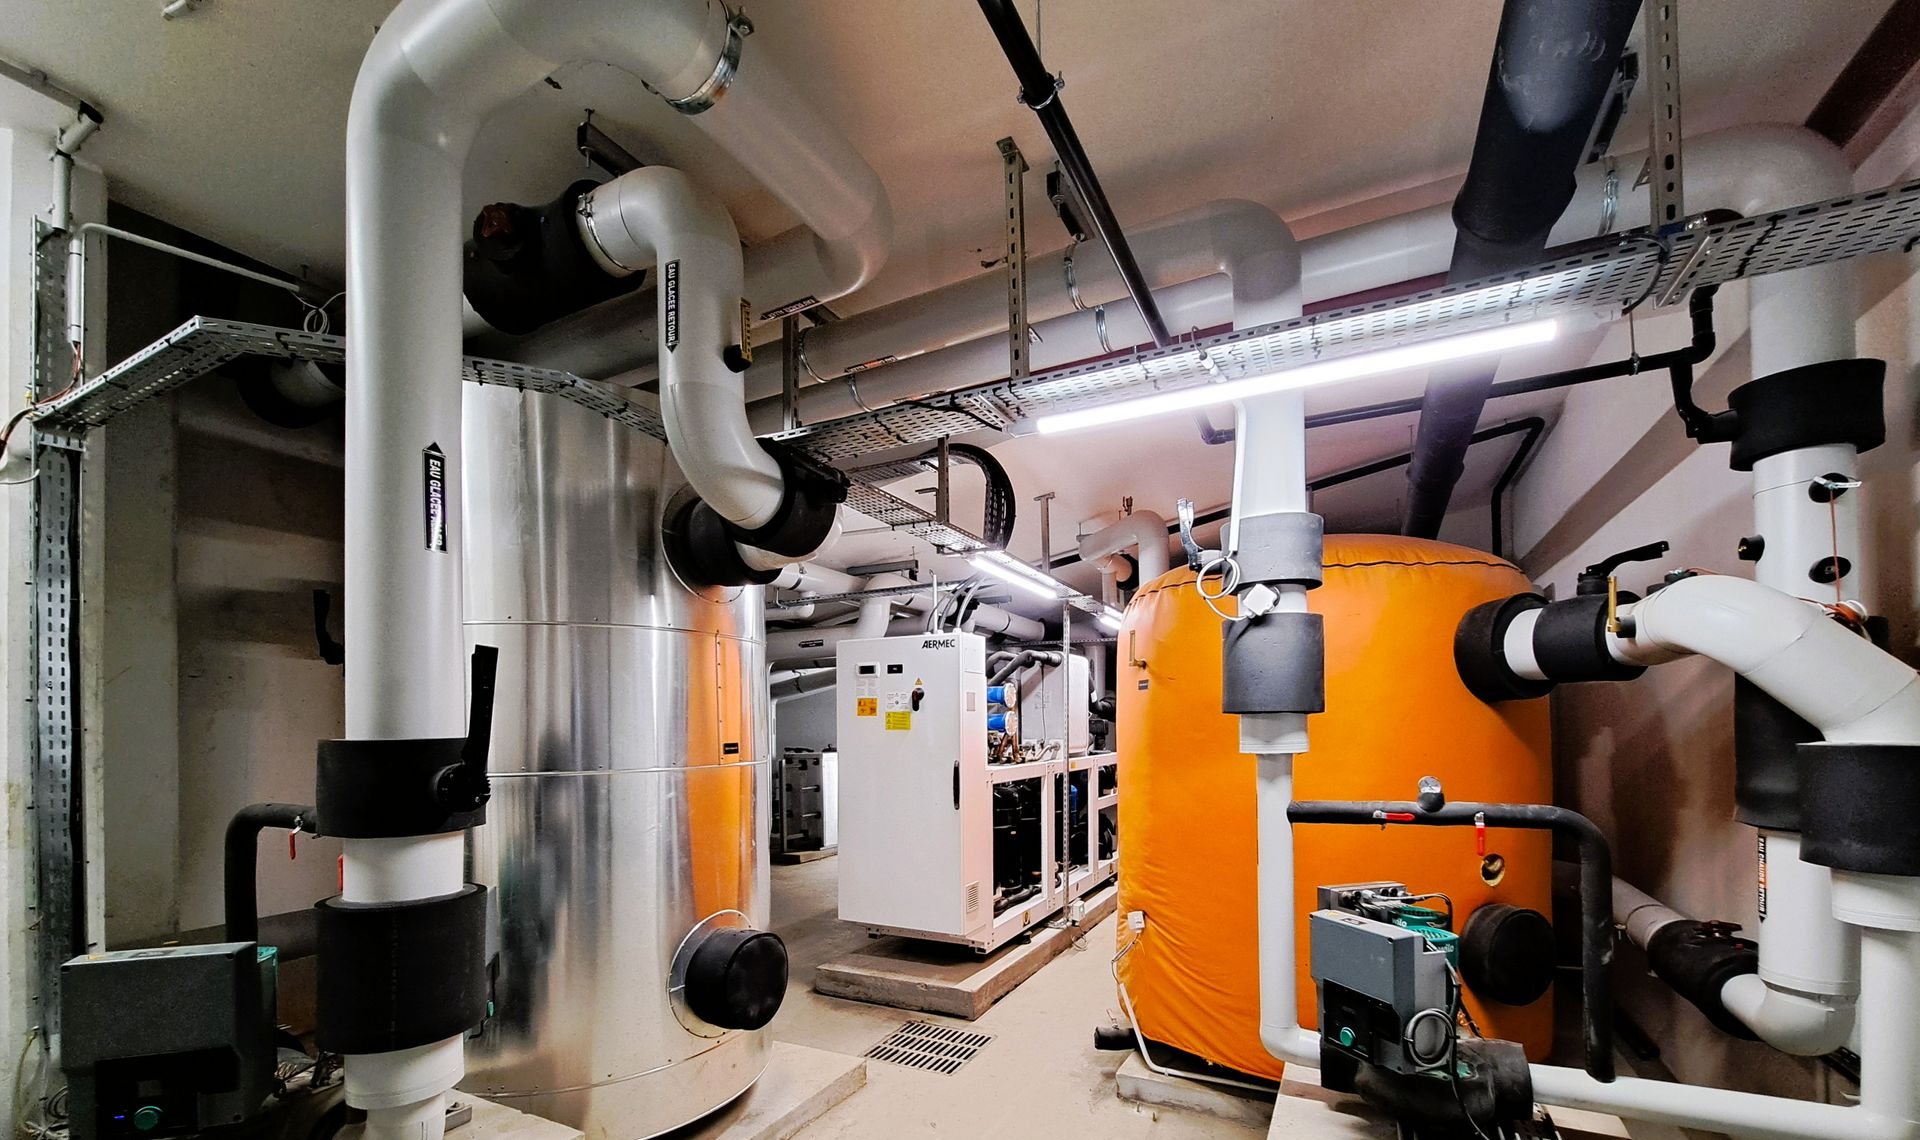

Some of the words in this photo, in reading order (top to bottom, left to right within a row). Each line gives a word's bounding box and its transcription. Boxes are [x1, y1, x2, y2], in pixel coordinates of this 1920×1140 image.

[667, 263, 676, 279] EAU
[667, 280, 676, 310] GLACEE
[667, 311, 676, 343] RETOUR
[429, 459, 441, 478] EAU
[429, 480, 442, 516] GLACEE
[921, 639, 955, 650] AERMEC
